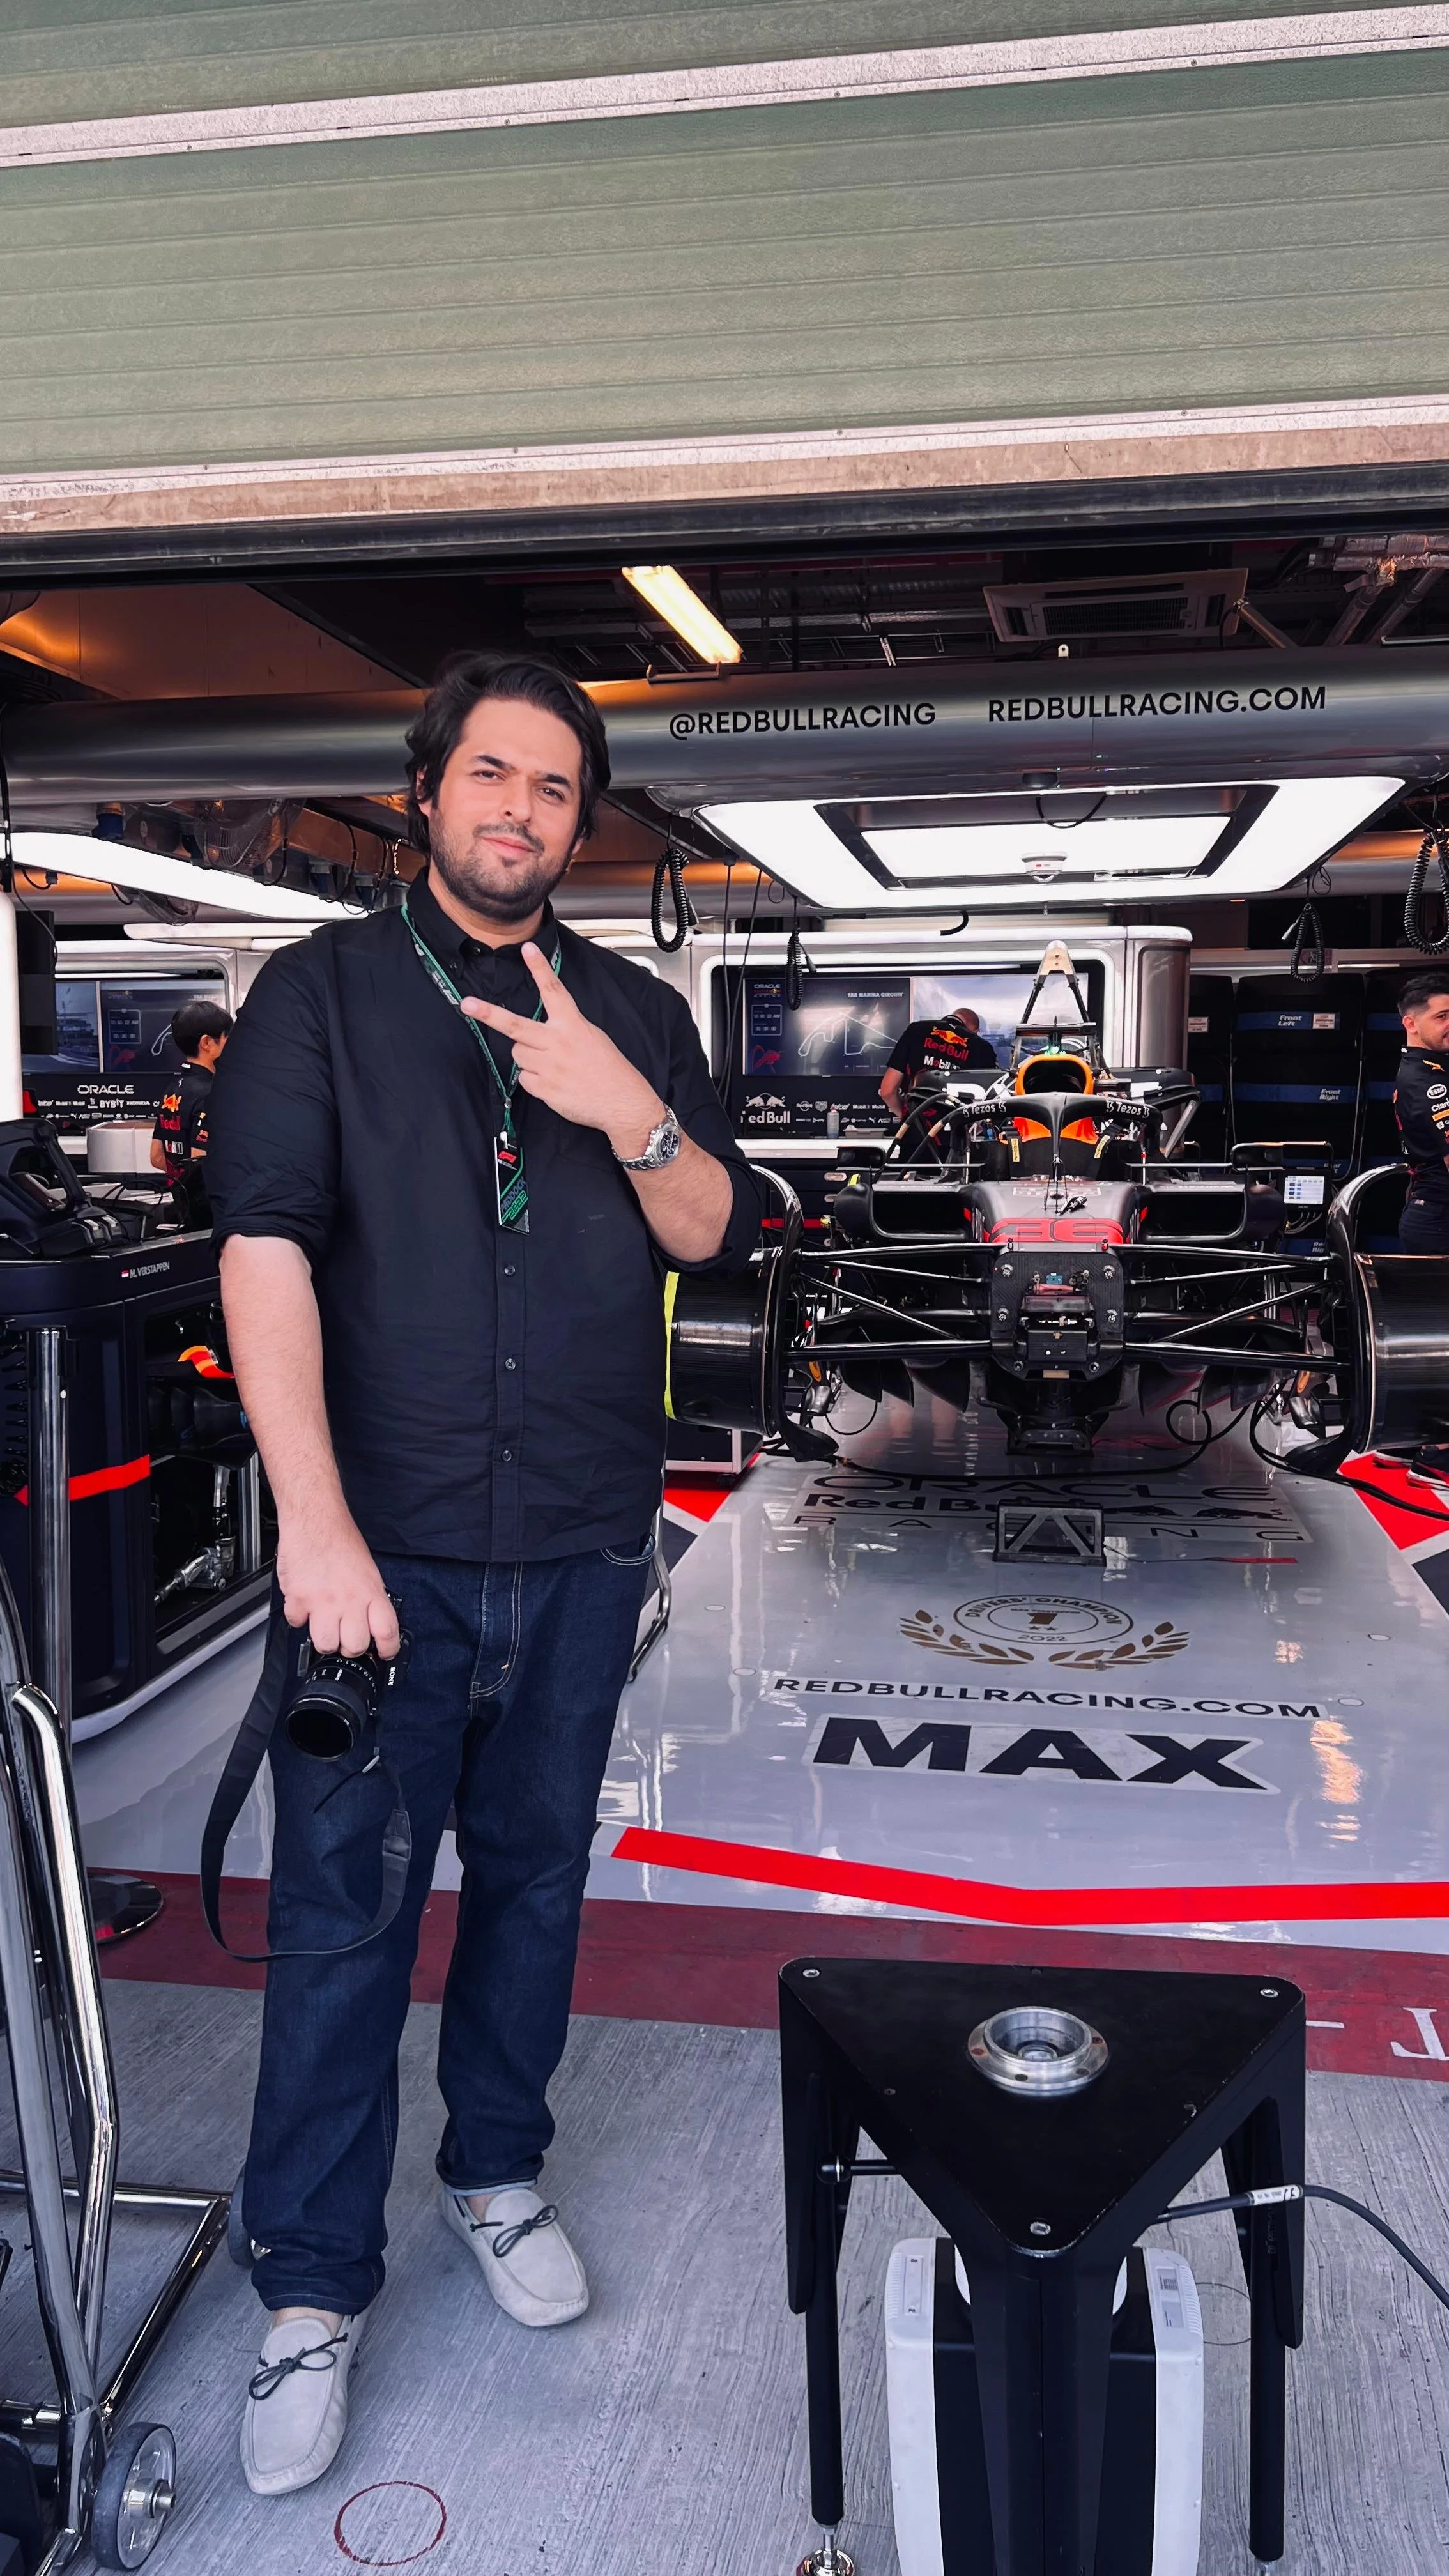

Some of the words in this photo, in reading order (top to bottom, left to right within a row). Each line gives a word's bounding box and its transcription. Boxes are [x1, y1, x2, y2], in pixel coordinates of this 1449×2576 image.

[988, 686, 1326, 723] REDBULLRACING.COM
[670, 703, 936, 741] @REDBULLRACING
[923, 1037, 947, 1054] Red
[947, 1045, 970, 1061] Bull
[924, 1055, 951, 1070] Mobil
[77, 1085, 134, 1094] ORACLE
[100, 1098, 124, 1108] BYBIT
[971, 1103, 996, 1116] Tezos
[1116, 1101, 1142, 1116] Tezos
[137, 1261, 170, 1276] VERSTAPPEN
[813, 1475, 1278, 1501] ORACLE
[804, 1493, 926, 1511] Red
[1027, 1612, 1058, 1625] 1
[1035, 1597, 1123, 1625] CHAMPION
[388, 1666, 396, 1686] SONY
[774, 1678, 1321, 1718] REDBULLRACING.COM
[813, 1717, 1268, 1790] MAX
